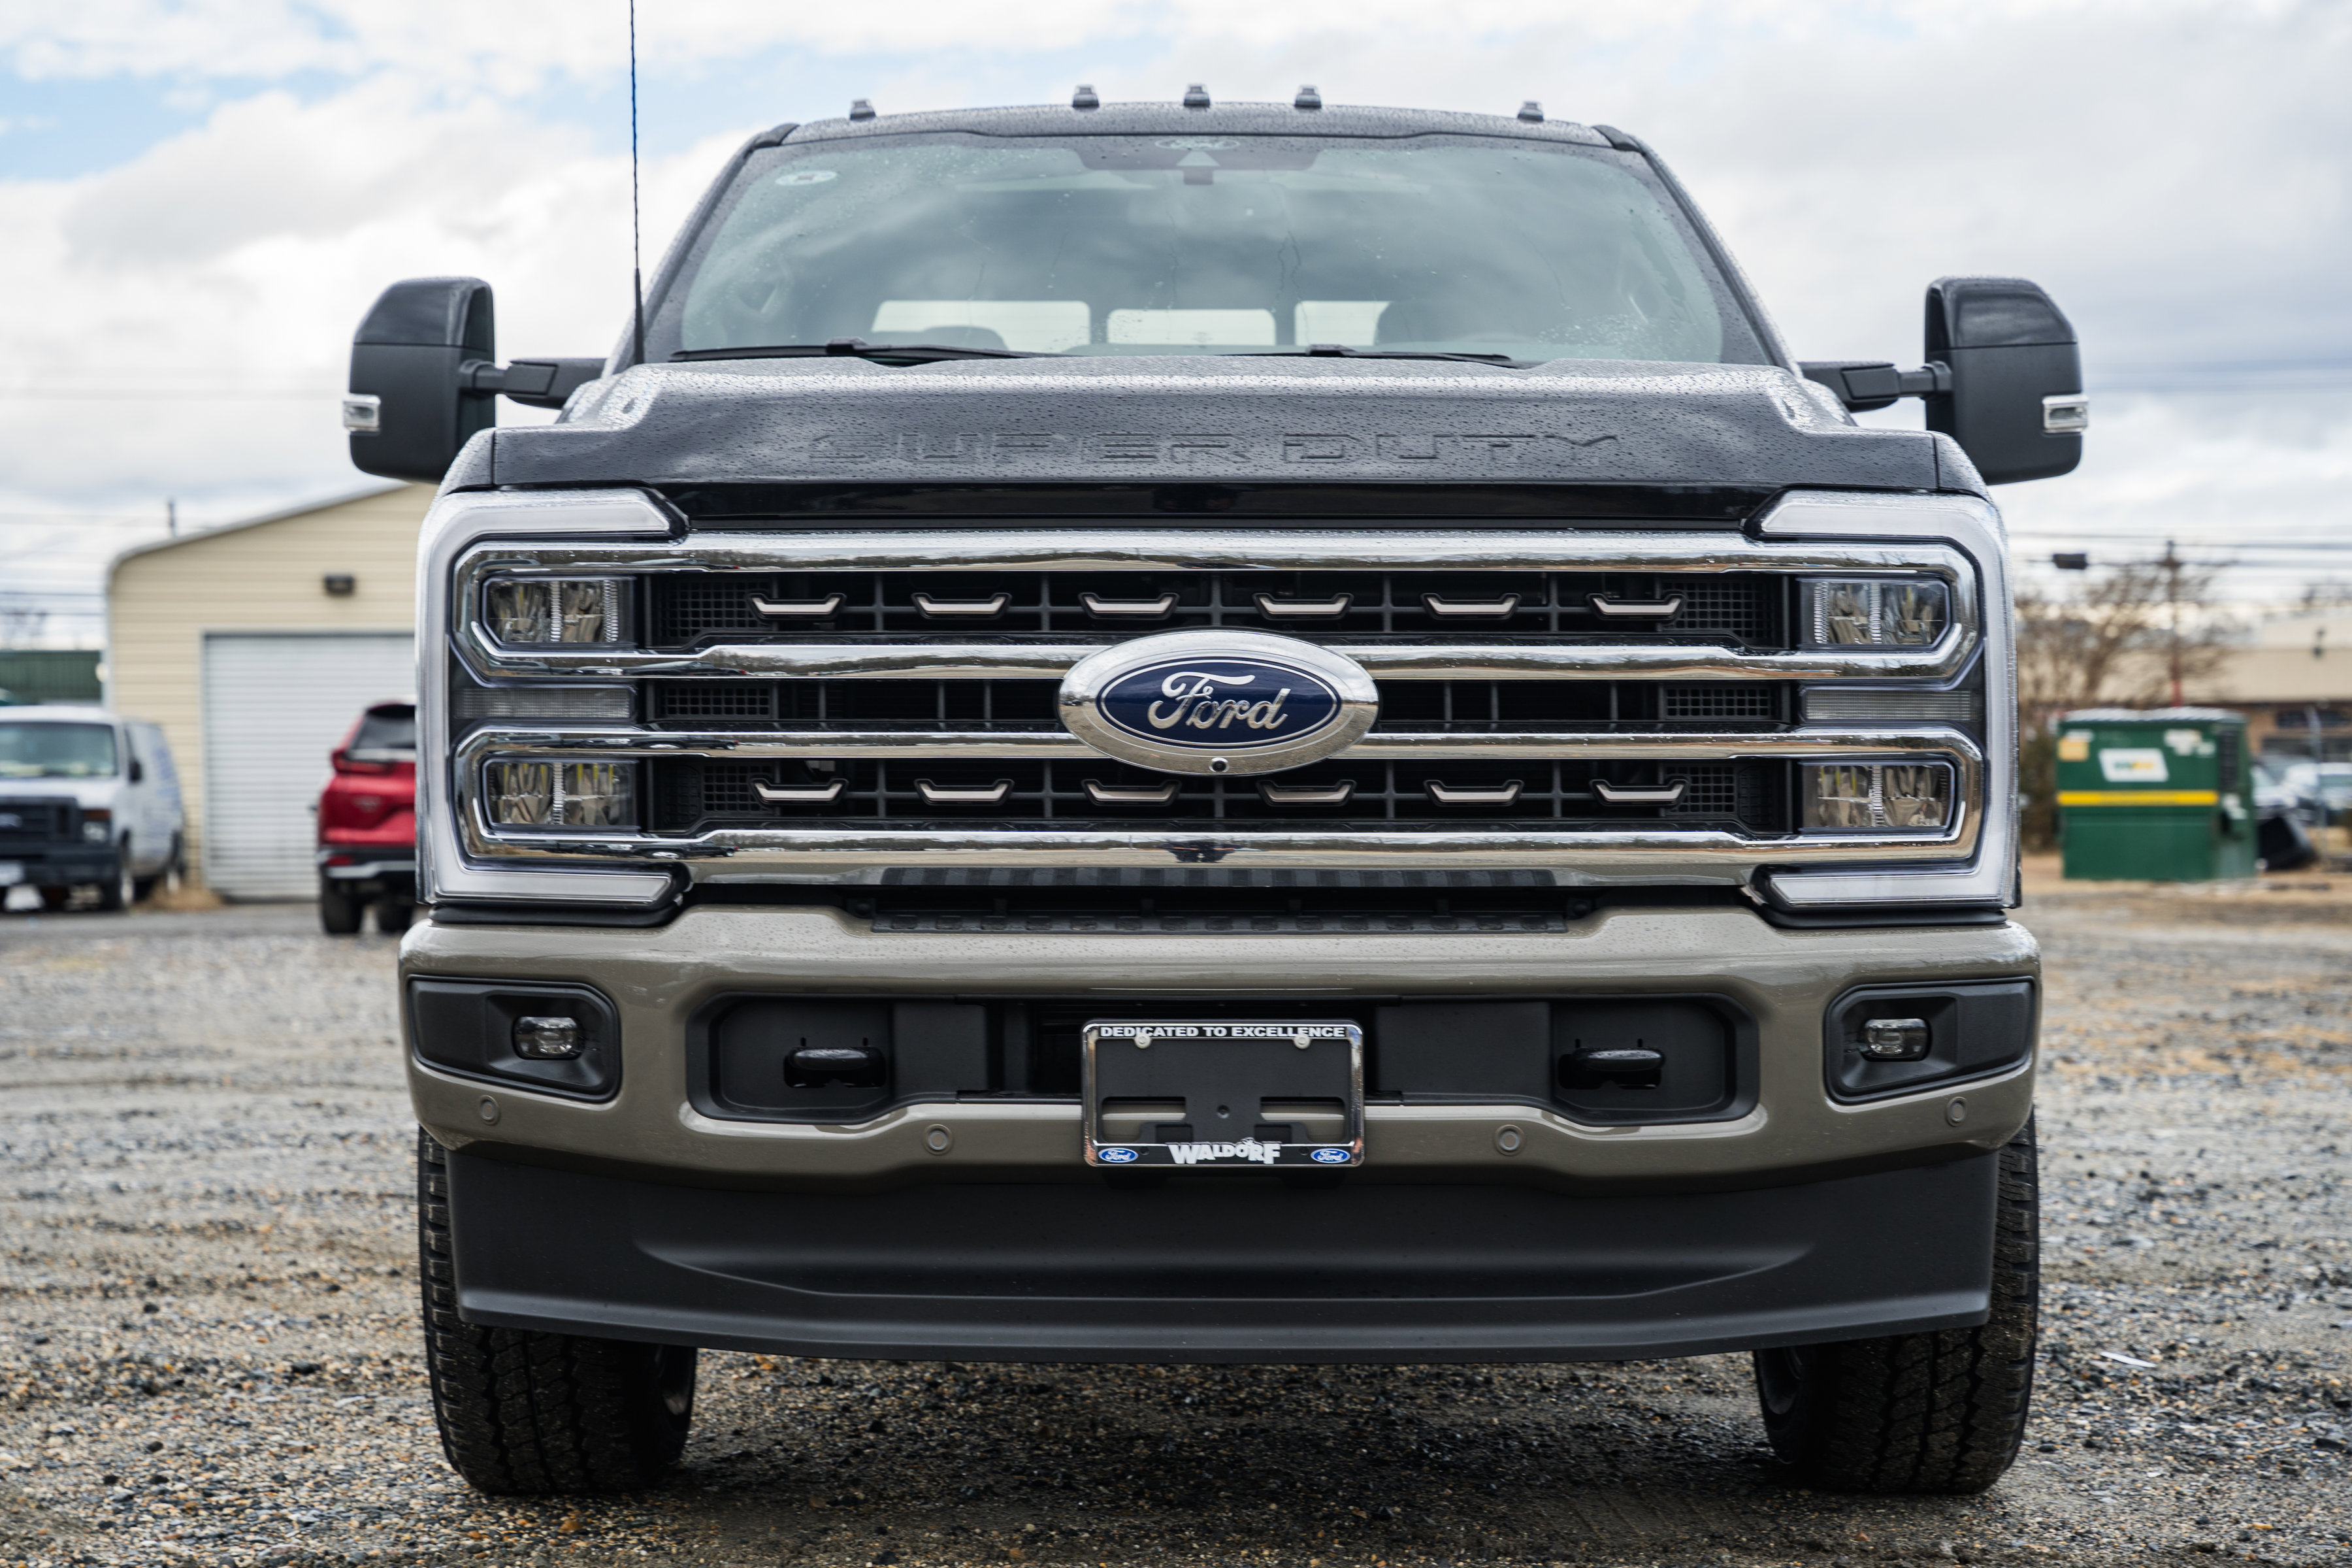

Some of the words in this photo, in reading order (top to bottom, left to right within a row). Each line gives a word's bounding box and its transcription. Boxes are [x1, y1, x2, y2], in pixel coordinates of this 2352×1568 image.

[811, 433, 1252, 463] SUPER
[1283, 433, 1618, 465] DUTY
[1148, 671, 1292, 729] Ford
[1100, 1026, 1199, 1037] DEDICATED
[1203, 1026, 1228, 1037] TO
[1231, 1026, 1345, 1037] EXCELLENCE
[1166, 1141, 1281, 1164] WALDORF
